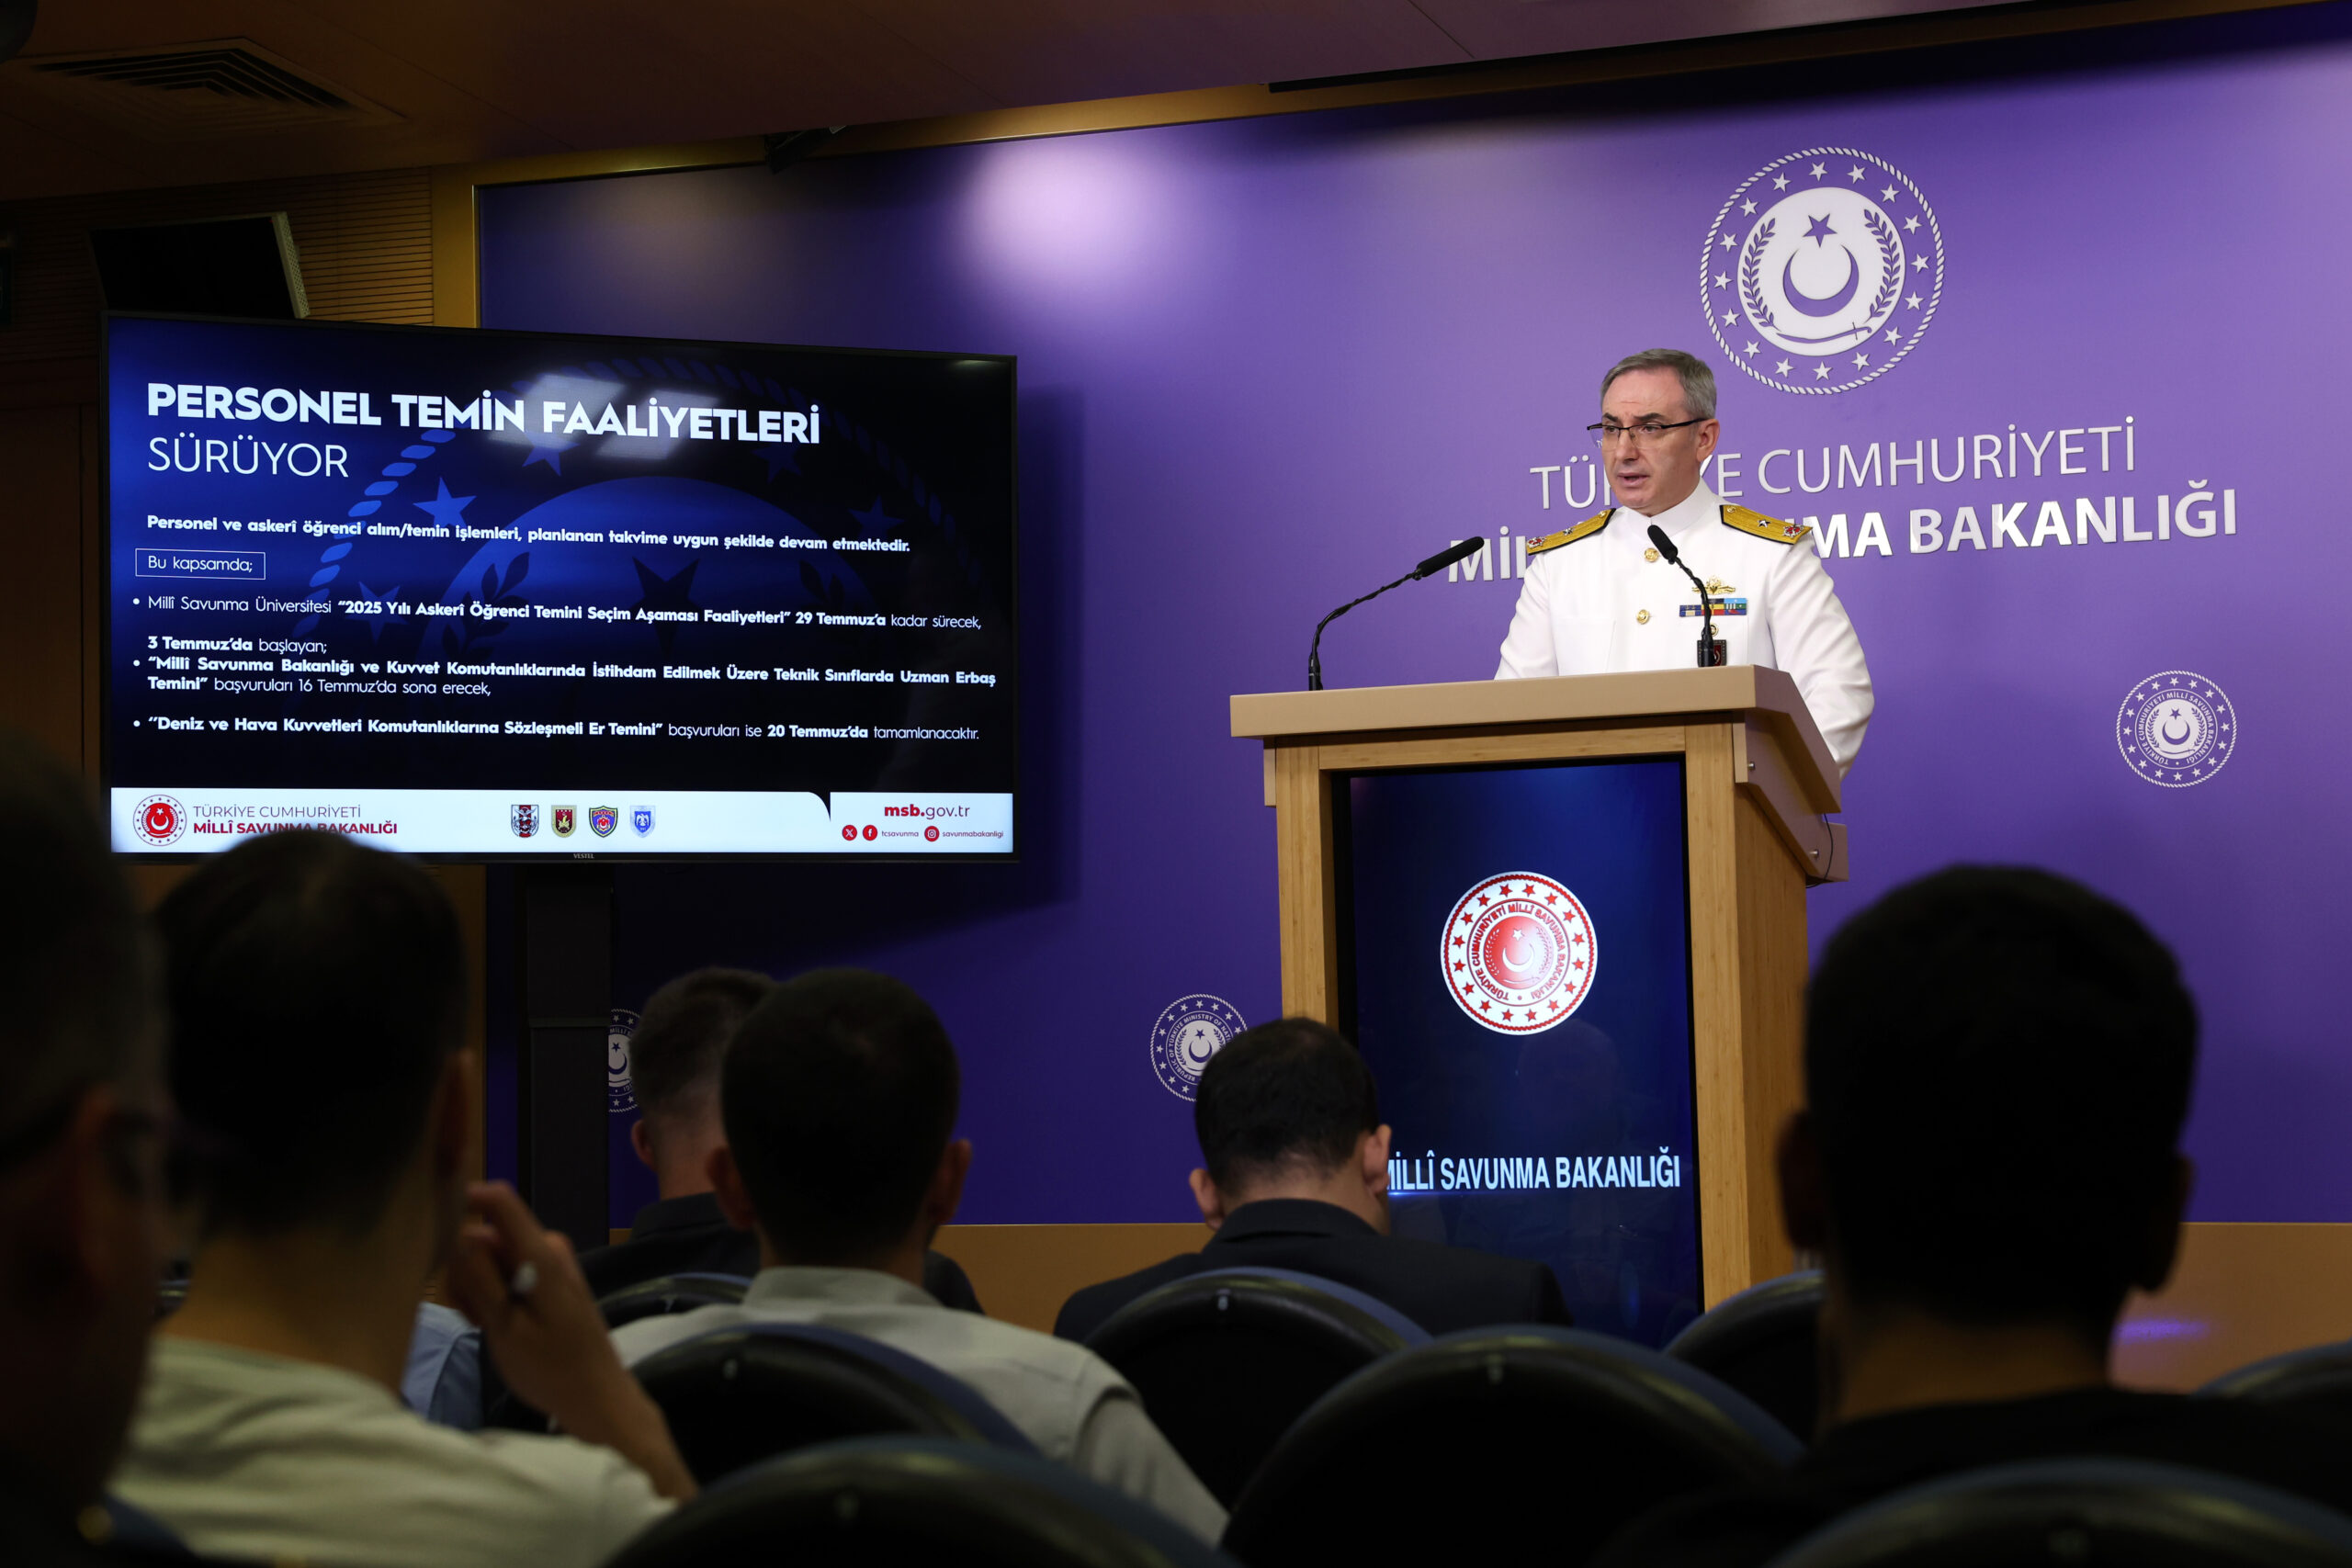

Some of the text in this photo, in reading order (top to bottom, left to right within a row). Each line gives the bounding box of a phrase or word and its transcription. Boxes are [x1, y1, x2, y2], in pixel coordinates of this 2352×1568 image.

[147, 382, 820, 444] PERSONEL TEMİN FAALİYETLERİ
[148, 432, 349, 478] SÜRÜYOR
[1756, 415, 2135, 495] CUMHURİYETİ
[147, 514, 910, 552] Personel ve askerî öğrenci alım/temin işlemleri, planlanan takvime uygun şekilde devam etmektedir.
[1449, 526, 1529, 582] MİL
[1909, 479, 2237, 557] BAKANLIĞI
[148, 555, 253, 573] Bu kapsamda;
[148, 595, 175, 609] Millî
[180, 595, 249, 612] Savunma
[255, 595, 332, 614] Üniversitesi
[337, 600, 383, 615] “2025
[386, 601, 412, 615] Yılı
[414, 602, 465, 616] Askerî
[469, 600, 530, 621] Öğrenci
[533, 604, 582, 619] Temini
[587, 605, 631, 624] Seçim
[635, 607, 699, 625] Aşaması
[795, 611, 813, 625] 29
[890, 614, 928, 627] kadar
[932, 615, 982, 630] sürecek,
[147, 636, 158, 649] 3
[258, 637, 327, 655] başlayan;
[198, 656, 274, 671] Savunma
[281, 658, 355, 677] Bakanlığı
[360, 662, 380, 673] ve
[387, 660, 441, 674] Kuvvet
[447, 661, 586, 677] Komutanlıklarında
[593, 660, 657, 679] İstihdam
[662, 665, 721, 680] Edilmek
[726, 663, 769, 681] Üzere
[773, 667, 820, 682] Teknik
[824, 668, 894, 682] Sınıflarda
[900, 670, 950, 683] Uzman
[956, 671, 997, 688] Erbaş
[214, 677, 293, 694] başvuruları
[298, 678, 313, 693] 16
[402, 682, 437, 694] sona
[442, 682, 492, 697] erecek,
[2188, 694, 2214, 726] SAVUNMA
[209, 720, 230, 731] ve
[234, 717, 277, 731] Hava
[283, 717, 362, 732] Kuvvetleri
[368, 718, 500, 734] Komutanlıklarına
[504, 720, 583, 739] Sözleşmeli
[589, 722, 605, 735] Er
[668, 723, 740, 739] başvuruları
[745, 724, 763, 738] ise
[767, 724, 786, 738] 20
[873, 726, 979, 739] tamamlanacaktır.
[193, 806, 361, 818] TÜRKİYE CUMHURİYETİ
[193, 819, 233, 834] MİLLÎ
[884, 803, 970, 820] msb.gov.tr
[942, 829, 1004, 840] savunmabakanligi
[1441, 1156, 1551, 1190] SAVUNMA
[1555, 1145, 1680, 1189] BAKANLIĞI
